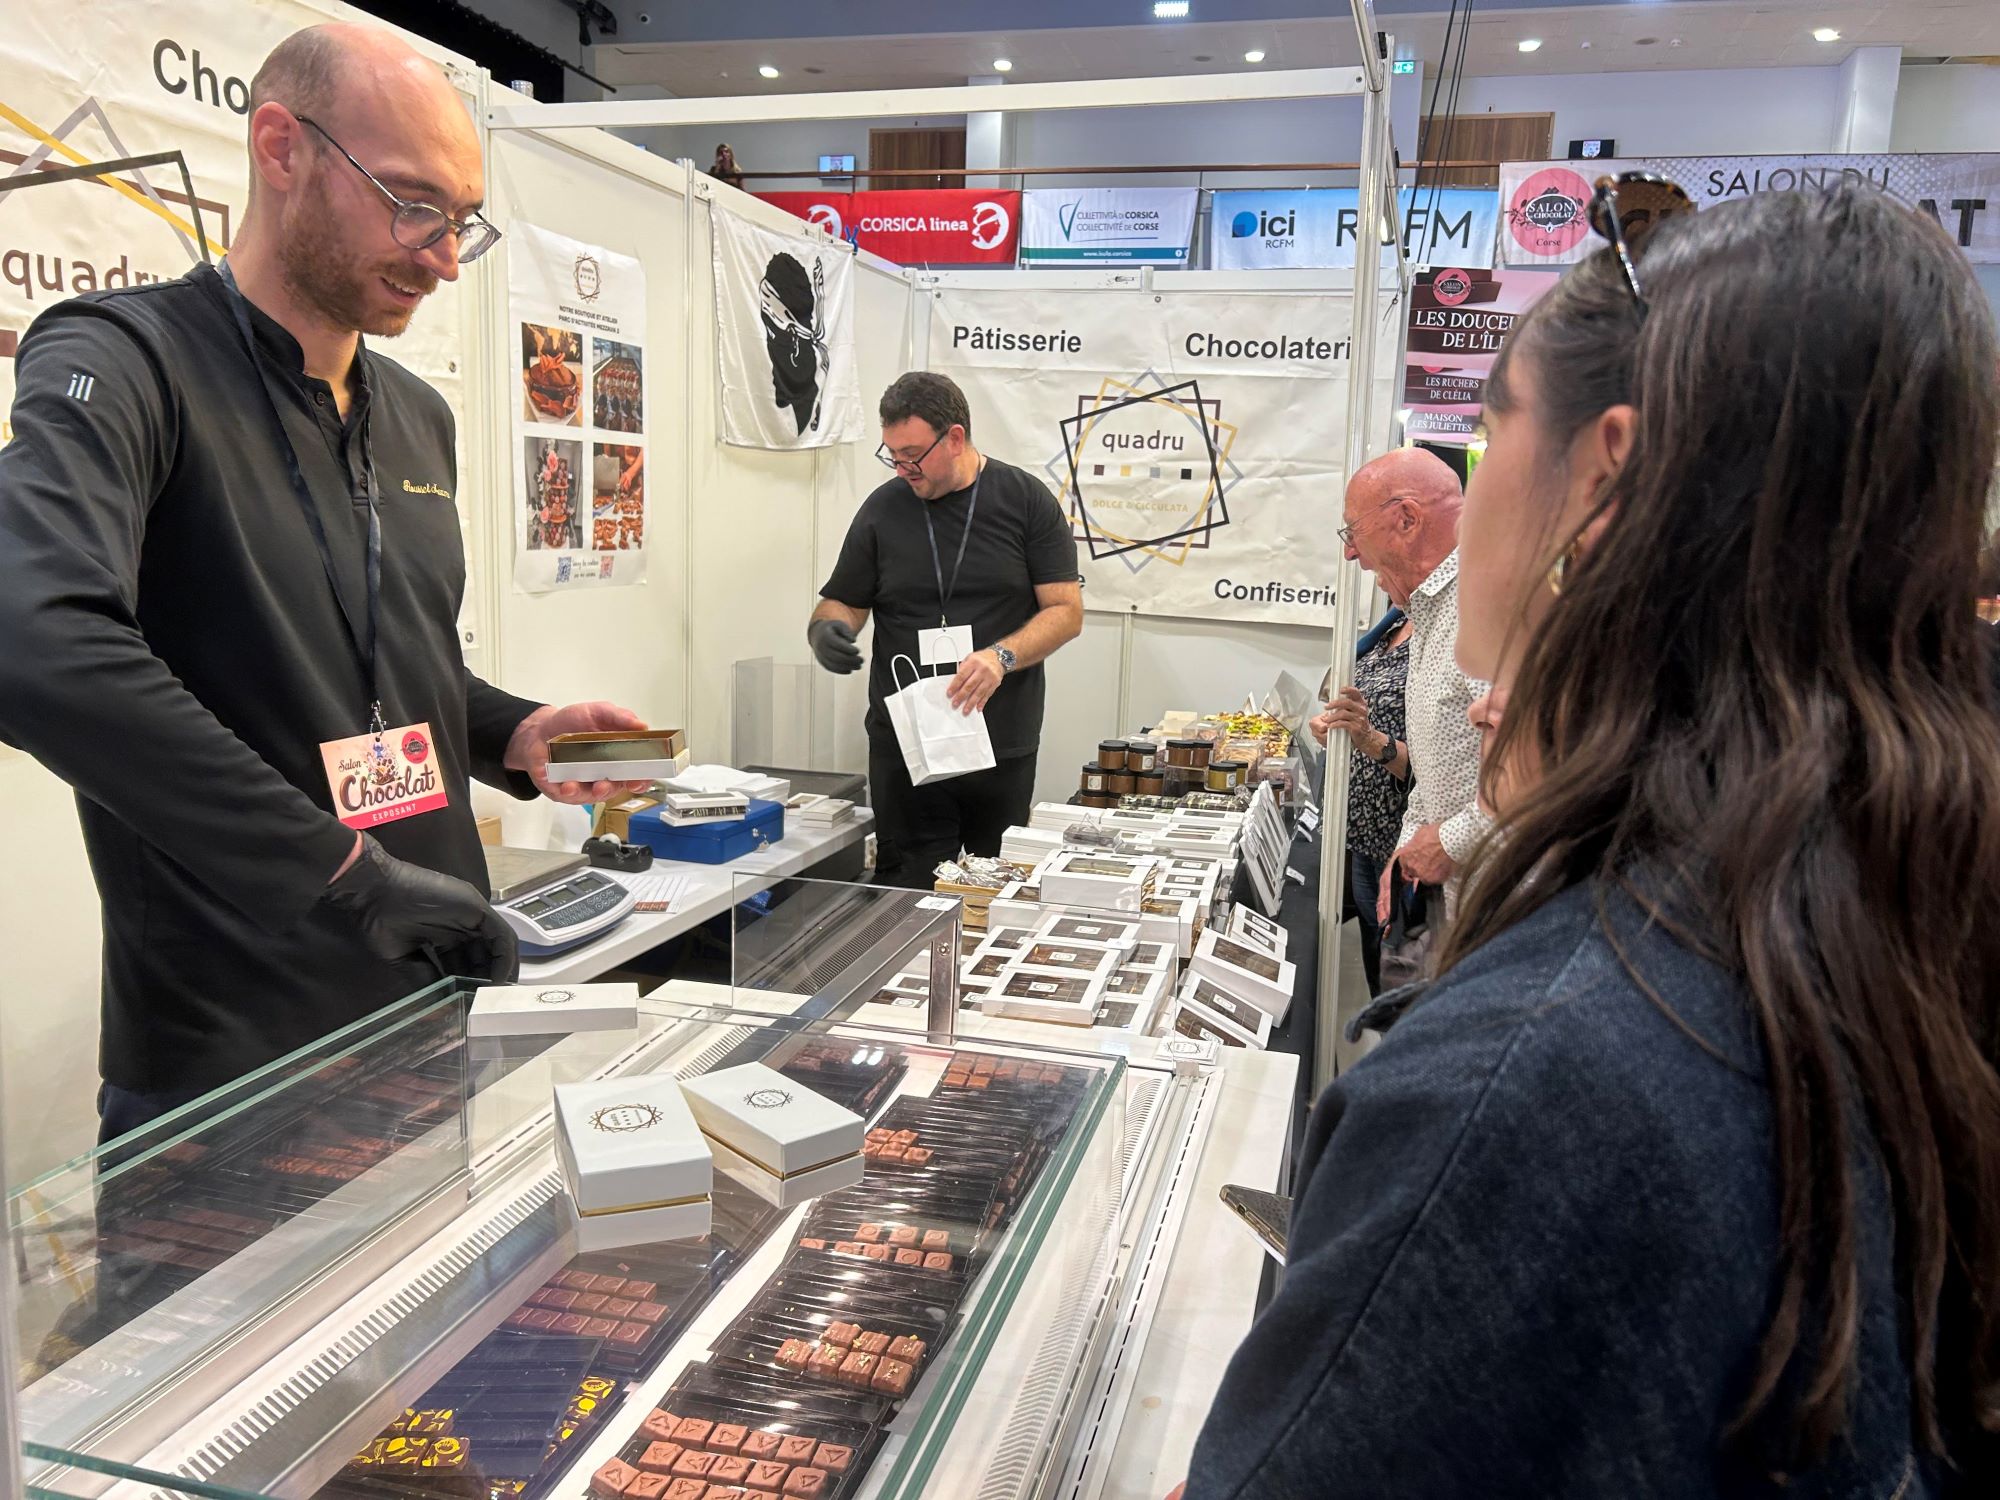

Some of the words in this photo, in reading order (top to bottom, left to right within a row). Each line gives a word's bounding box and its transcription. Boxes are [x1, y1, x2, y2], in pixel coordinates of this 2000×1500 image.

[1528, 202, 1573, 213] SALON
[1125, 211, 1159, 219] CORSICA
[1533, 211, 1572, 219] CHOCOLAT
[860, 217, 927, 232] CORSICA
[929, 217, 969, 231] linea
[1133, 222, 1159, 230] CORSE
[1260, 209, 1295, 237] ici
[1336, 209, 1472, 248] RFM
[1265, 239, 1295, 249] RCFM
[1536, 238, 1561, 246] Corse
[2, 249, 172, 300] quadr
[1415, 310, 1446, 327] LES
[953, 326, 1082, 353] Pâtisserie
[1185, 332, 1352, 360] Chocolateri
[1442, 332, 1465, 348] DE
[1425, 377, 1440, 387] LES
[1442, 379, 1479, 389] RUCHERS
[1430, 389, 1442, 399] DE
[1443, 388, 1471, 400] CLÉLIA
[1424, 413, 1463, 422] MAISON
[1427, 421, 1472, 432] JULIETTES
[1102, 429, 1184, 453] quadru
[1092, 499, 1123, 509] DOLCE
[1135, 502, 1189, 512] CICCULATA
[338, 758, 362, 772] Salon
[339, 763, 436, 812] Chocolat
[372, 803, 417, 822] EXPOSANT
